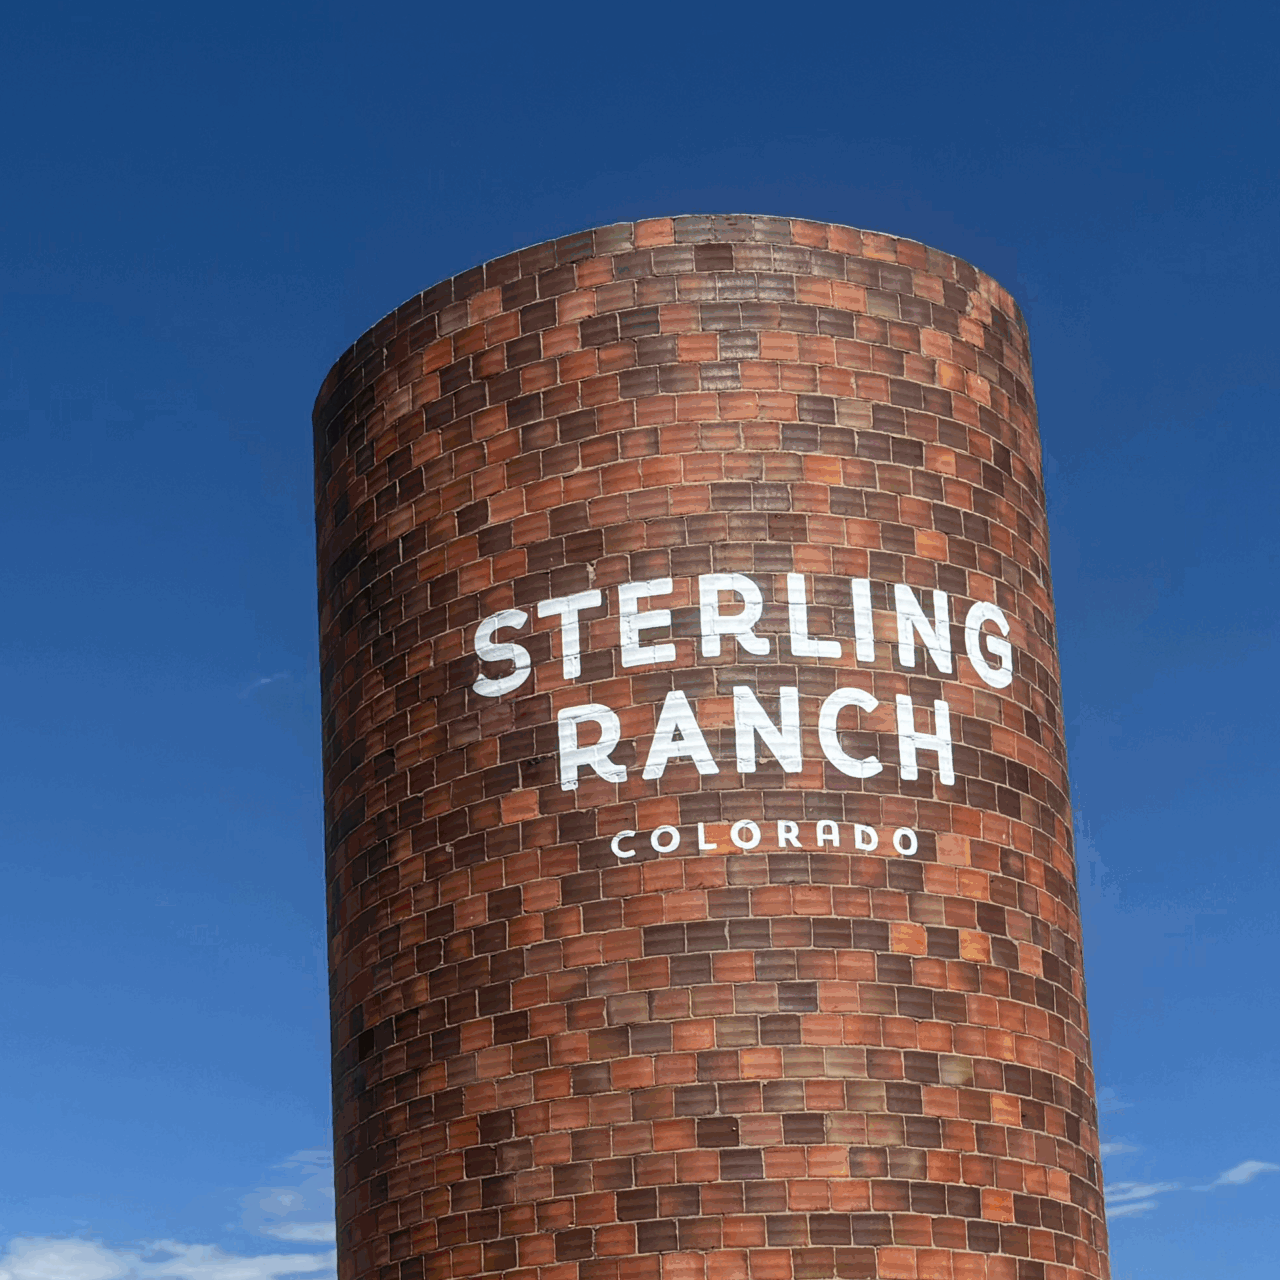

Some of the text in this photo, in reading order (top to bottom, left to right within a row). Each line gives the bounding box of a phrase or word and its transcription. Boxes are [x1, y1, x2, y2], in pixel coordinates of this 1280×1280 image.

[473, 572, 1013, 697] STERLING
[557, 685, 955, 791] RANCH
[610, 819, 918, 858] COLORADO
